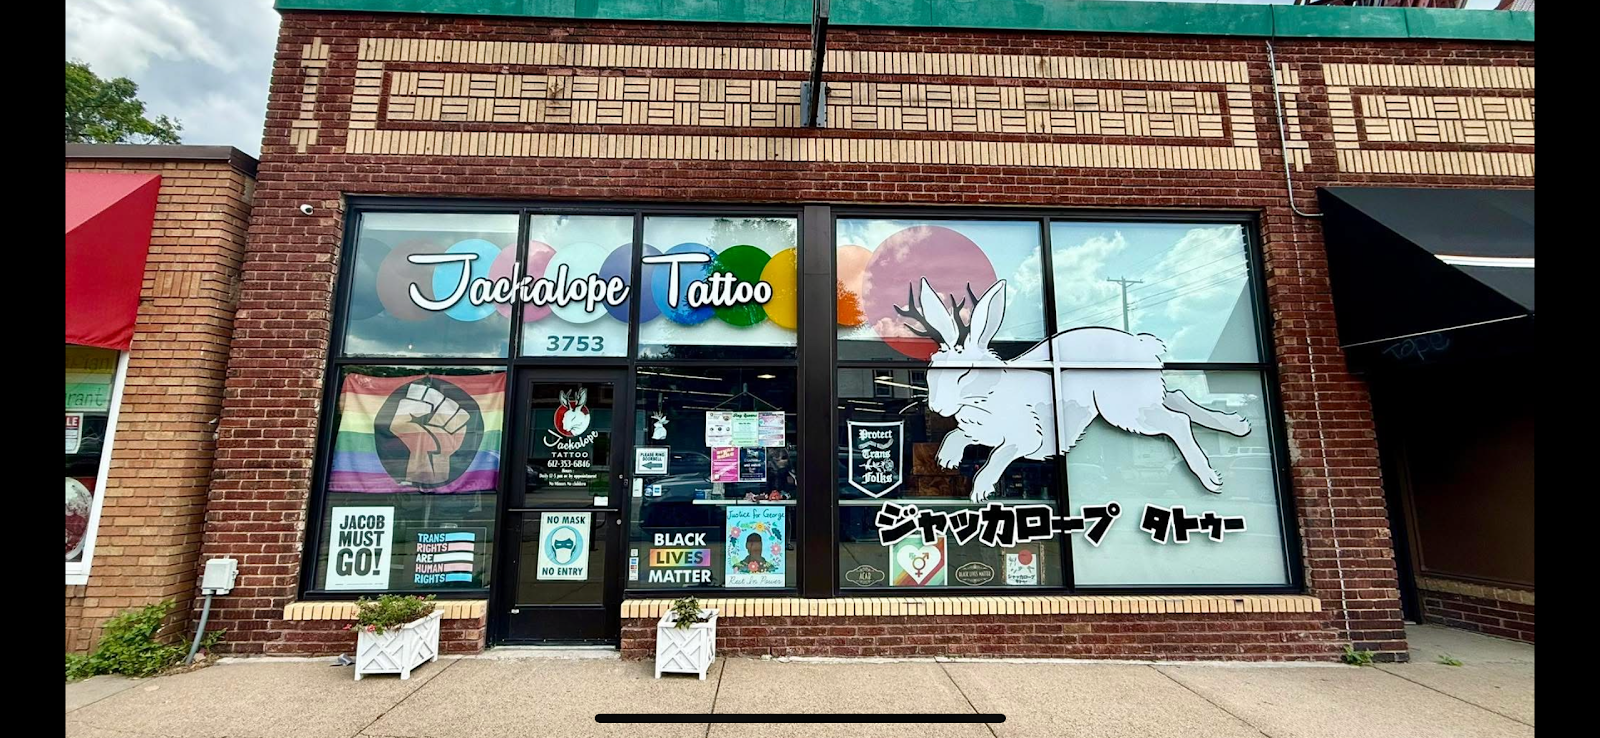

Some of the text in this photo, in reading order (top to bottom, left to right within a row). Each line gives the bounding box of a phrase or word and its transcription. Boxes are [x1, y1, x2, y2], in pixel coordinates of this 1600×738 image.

[407, 253, 773, 312] Jackalope Tattoo
[546, 335, 604, 352] 3753
[65, 387, 103, 407] rant
[543, 429, 599, 450] Jackalope
[858, 428, 893, 441] Protect
[861, 449, 891, 459] Trans
[547, 459, 591, 468] 612-353-6846
[861, 471, 893, 484] Folks
[546, 516, 586, 524] NO MASK
[727, 508, 785, 521] Justice for George
[339, 515, 386, 530] JACOB
[876, 500, 1247, 548] ジャッカロープ タトゥー
[338, 530, 385, 547] MUST
[418, 533, 446, 543] TRANS
[654, 533, 706, 546] BLACK
[416, 543, 448, 552] RIGHTS
[335, 548, 383, 577] GO!
[415, 554, 433, 563] ARE
[656, 551, 704, 564] LIVES
[415, 563, 445, 573] HUMAN
[542, 567, 583, 576] NO ENTRY
[414, 573, 446, 583] RIGHTS
[648, 569, 711, 583] MATTER
[729, 575, 745, 585] Rest
[760, 575, 782, 585] Power
